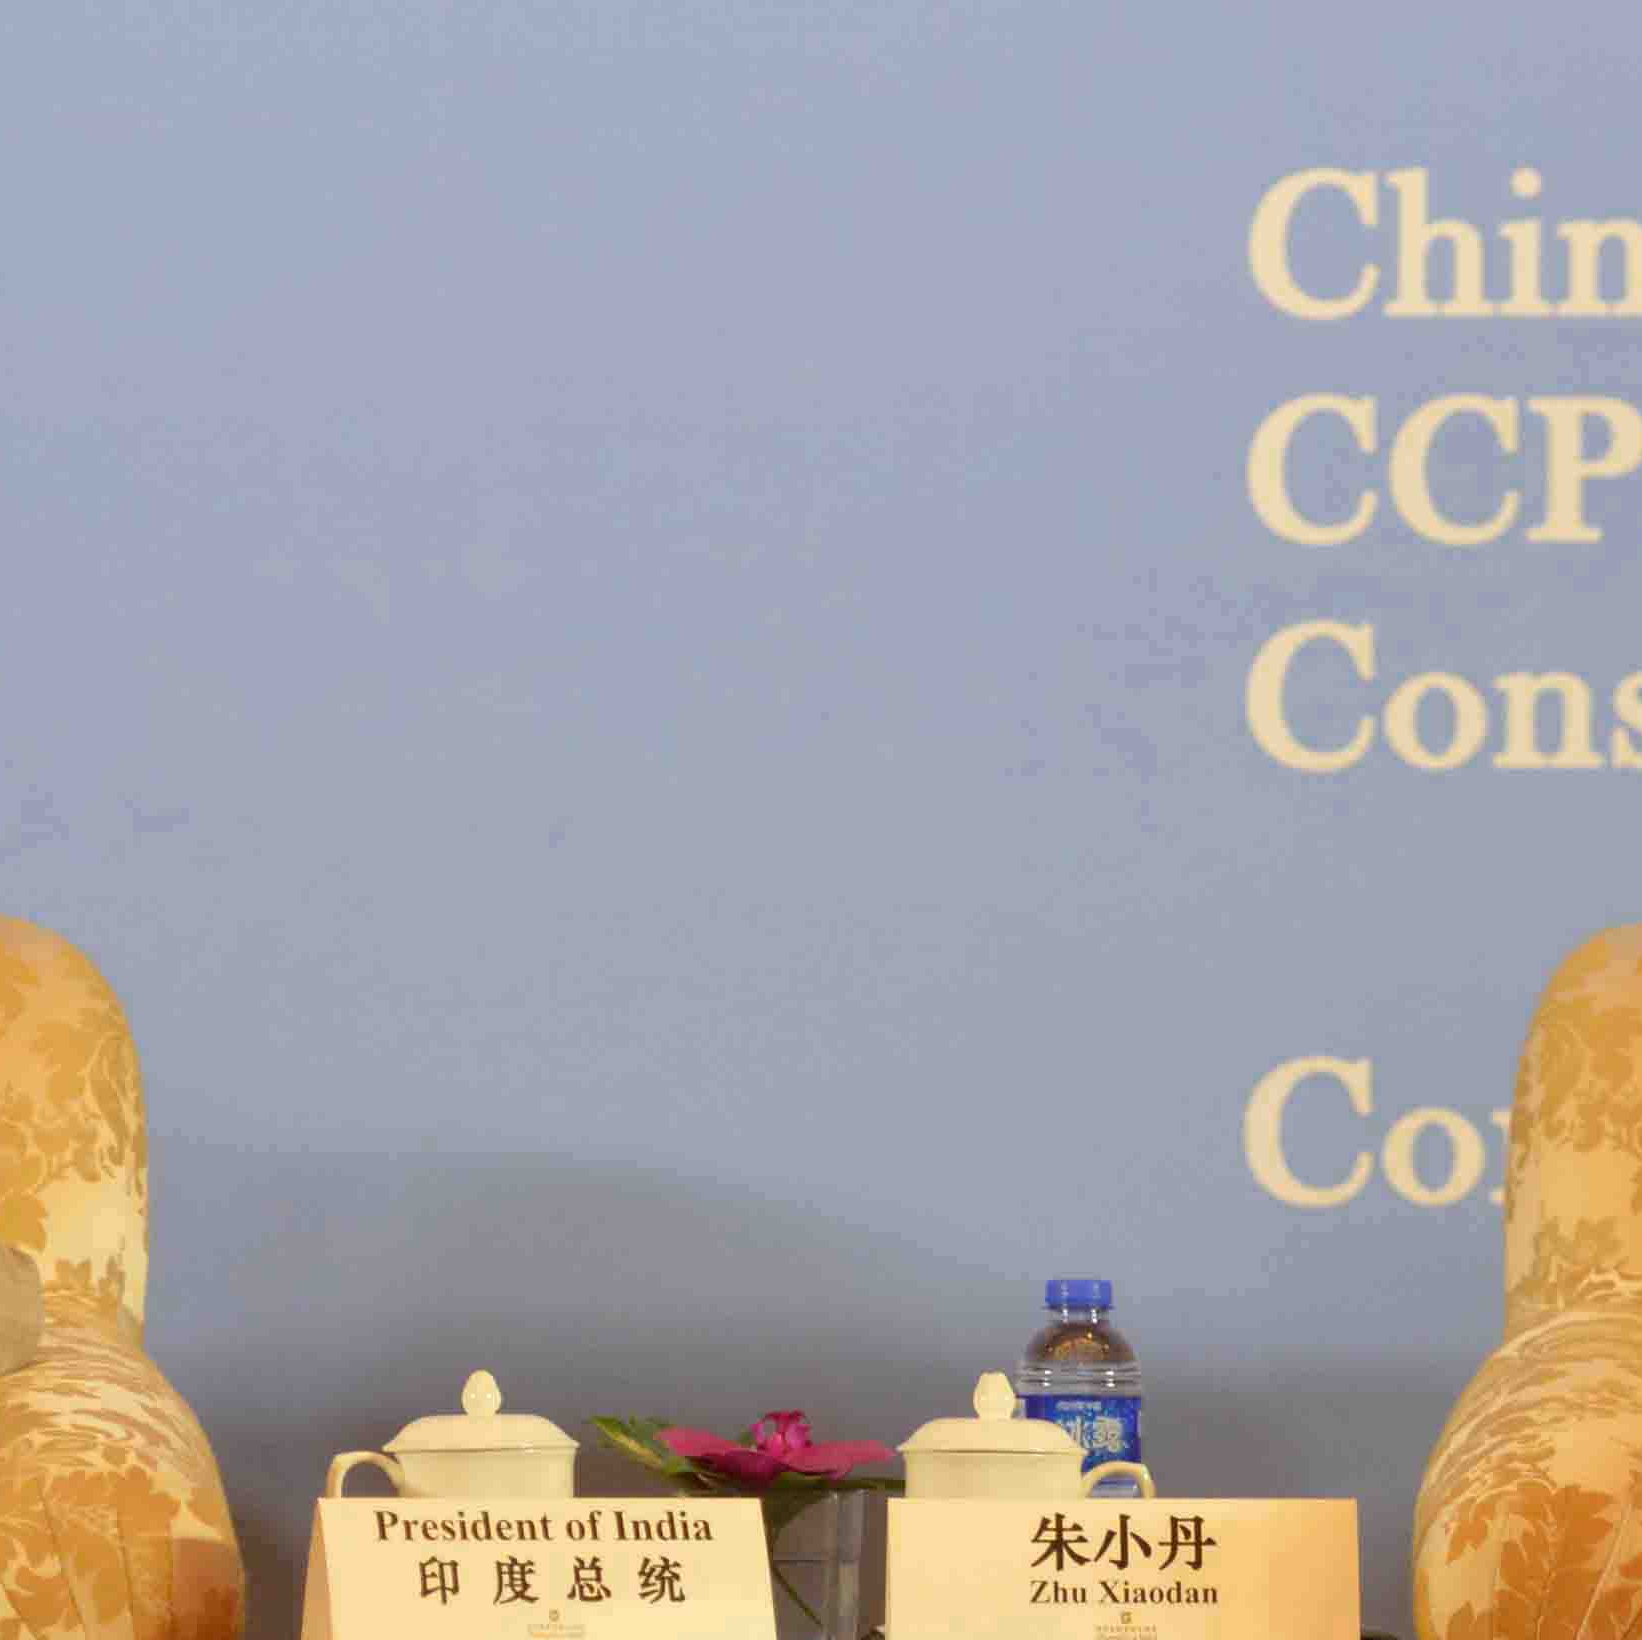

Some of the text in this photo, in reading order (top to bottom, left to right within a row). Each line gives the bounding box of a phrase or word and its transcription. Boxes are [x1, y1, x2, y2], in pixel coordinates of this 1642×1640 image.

[374, 1510, 714, 1541] President of India
[1030, 1512, 1218, 1573] 朱小丹
[417, 1555, 687, 1605] 印度总统
[1029, 1579, 1219, 1604] Zhu Xiaodan
